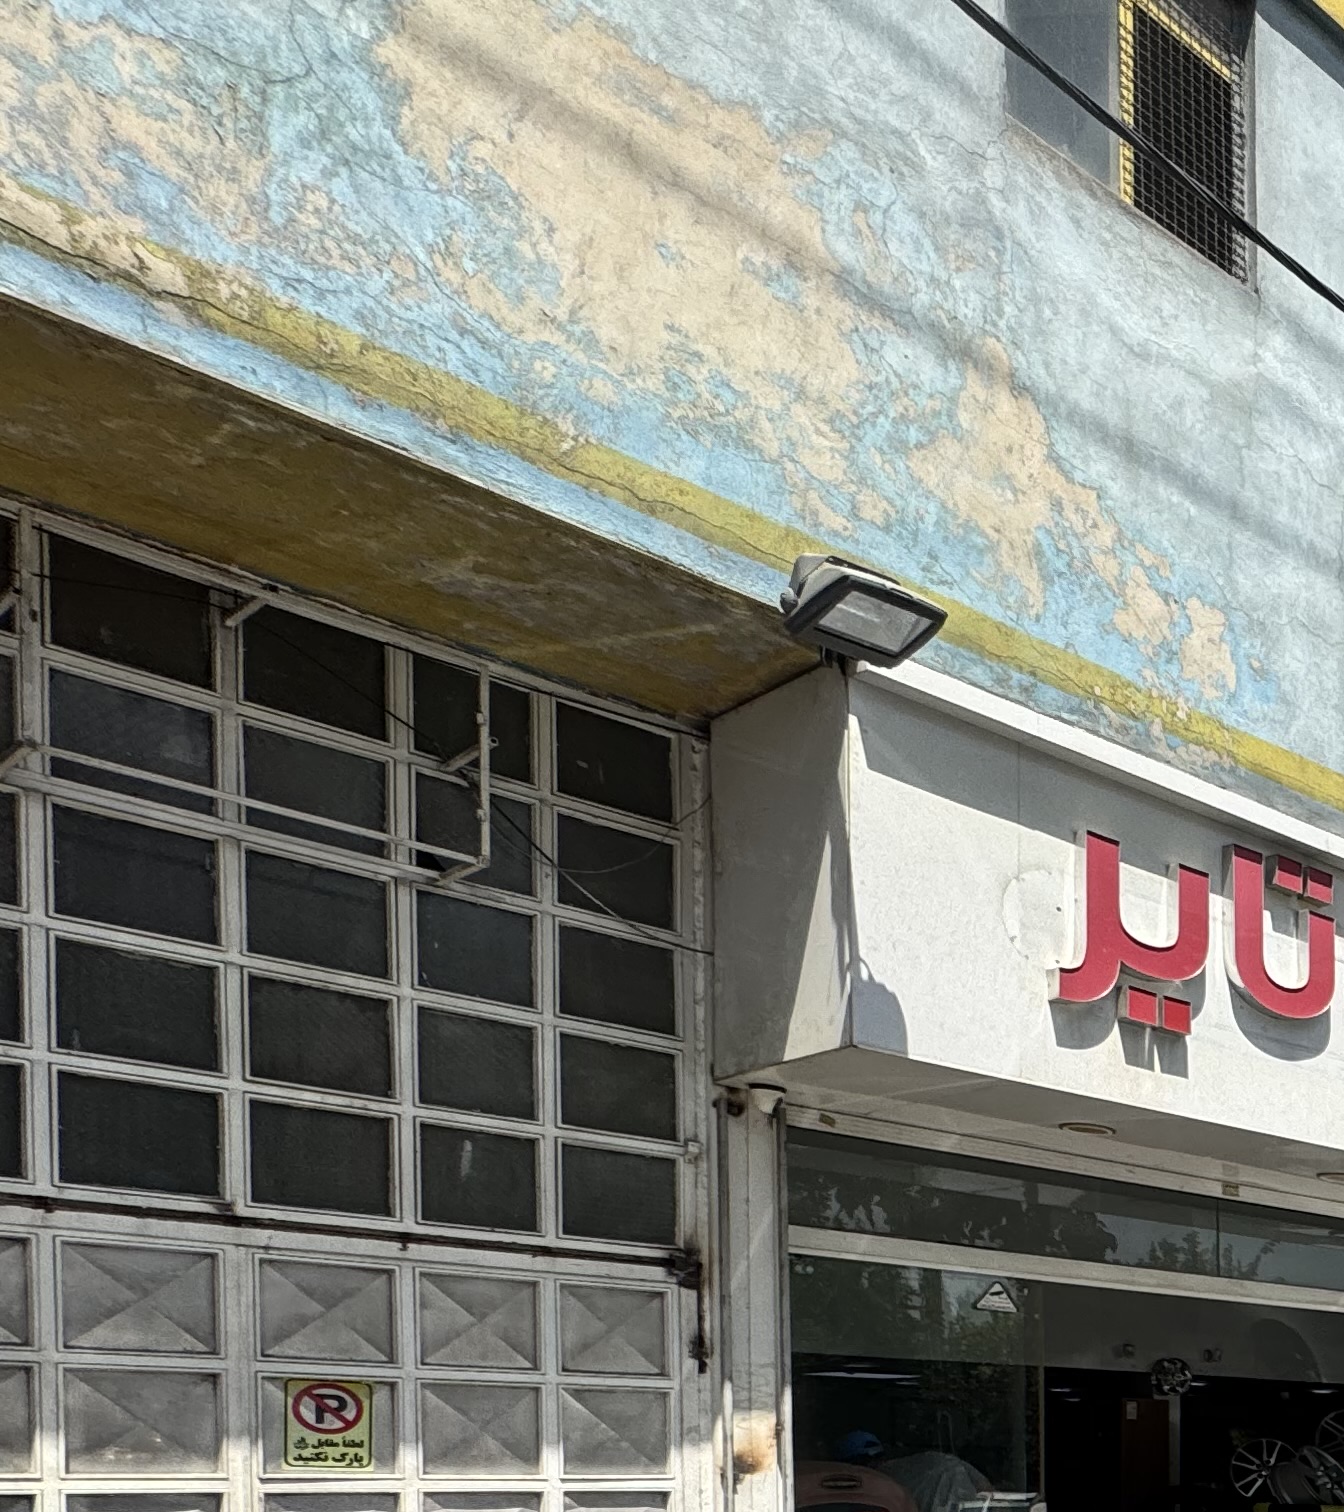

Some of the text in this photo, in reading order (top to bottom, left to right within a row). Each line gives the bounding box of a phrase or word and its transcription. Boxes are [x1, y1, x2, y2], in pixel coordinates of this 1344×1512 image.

[1050, 831, 1335, 1037] تایر
[311, 1438, 340, 1450] مقابل
[293, 1451, 364, 1467] پارک نکنید
